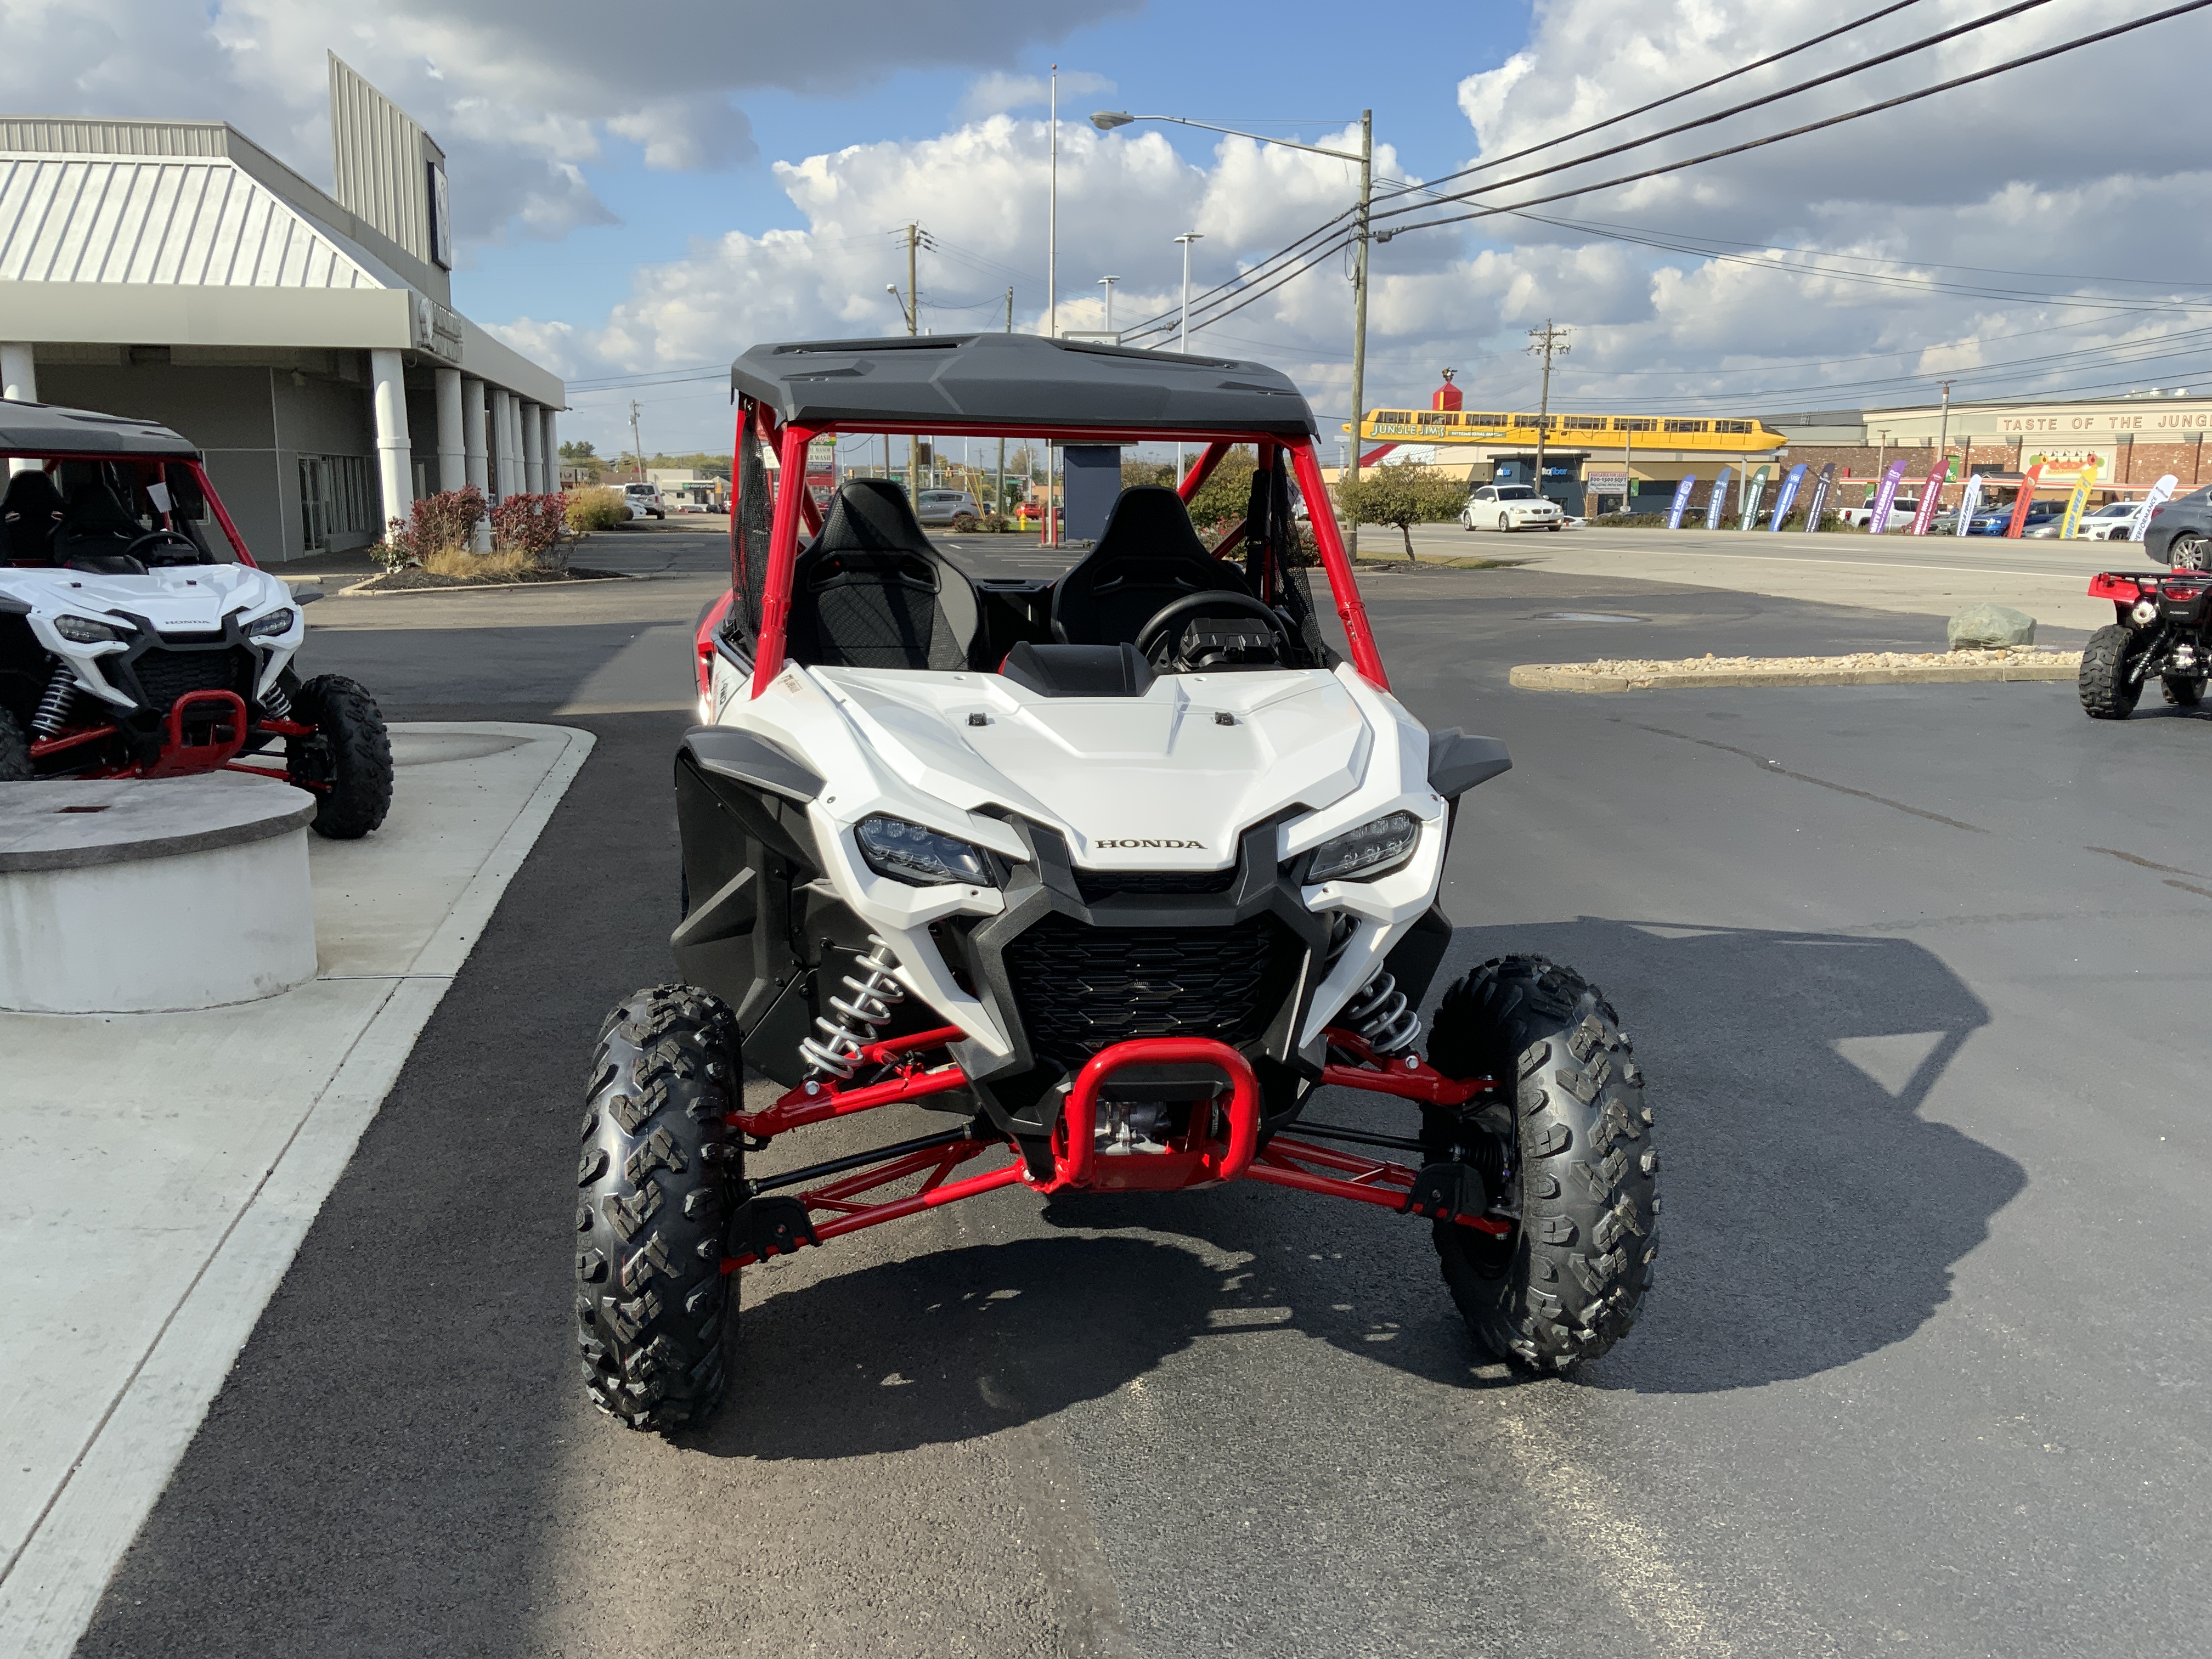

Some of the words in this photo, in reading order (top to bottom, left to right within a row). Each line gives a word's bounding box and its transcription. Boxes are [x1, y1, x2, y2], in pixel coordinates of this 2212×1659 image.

[1372, 424, 1417, 437] JUNGLE
[1419, 425, 1445, 438] JIM'S
[2004, 418, 2057, 430] TASTE
[2072, 417, 2094, 429] OF
[2109, 416, 2142, 428] THE
[2158, 414, 2212, 428] JUNG
[1674, 494, 1684, 510] YOU
[1744, 483, 1759, 517] TOWNSHIP
[1875, 479, 1893, 515] PLEASERS
[1921, 479, 1936, 512] HOLDINGS
[2133, 495, 2158, 541] PERFORMANCE
[1095, 839, 1208, 849] HONDA
